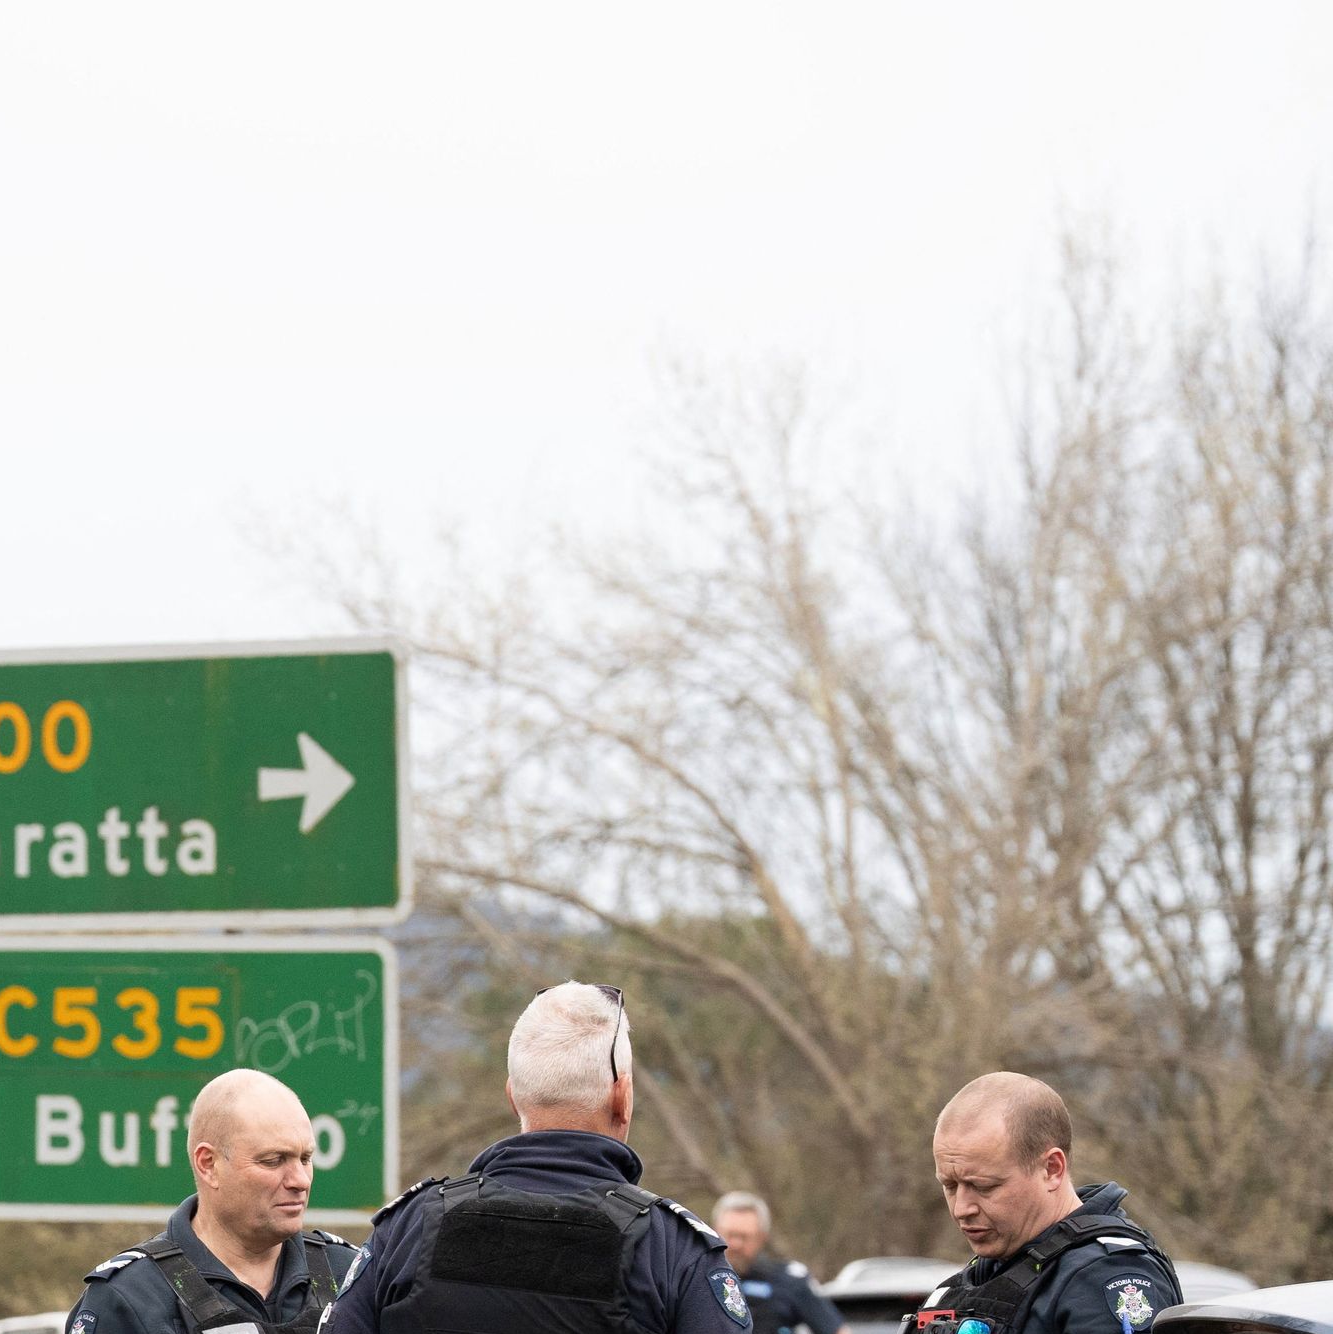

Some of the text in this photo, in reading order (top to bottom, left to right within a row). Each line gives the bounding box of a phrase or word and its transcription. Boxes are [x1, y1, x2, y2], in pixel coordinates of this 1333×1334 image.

[35, 1094, 346, 1170] Bufo
[1106, 1279, 1152, 1290] VICTORIA POLICE
